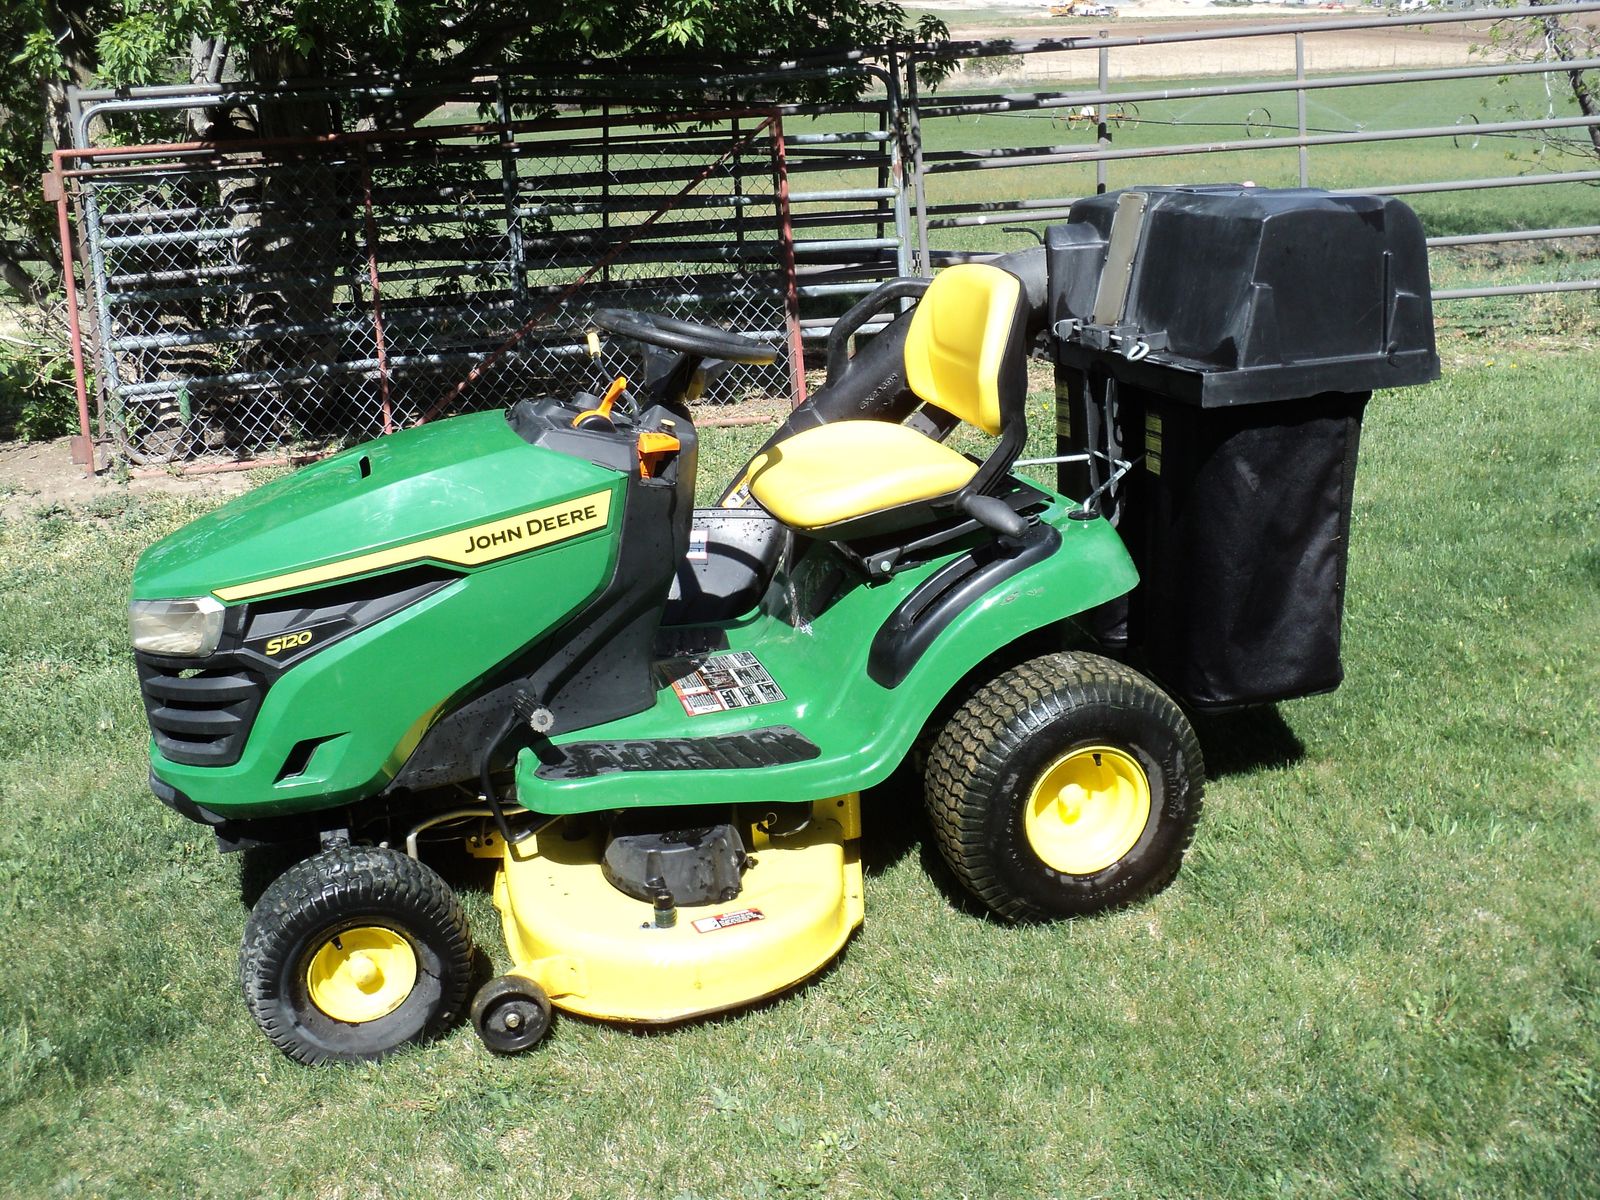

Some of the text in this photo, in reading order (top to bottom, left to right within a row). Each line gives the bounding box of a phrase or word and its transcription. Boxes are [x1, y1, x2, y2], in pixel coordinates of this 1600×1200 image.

[465, 505, 597, 554] JOHN DEERE
[265, 631, 313, 656] S120
